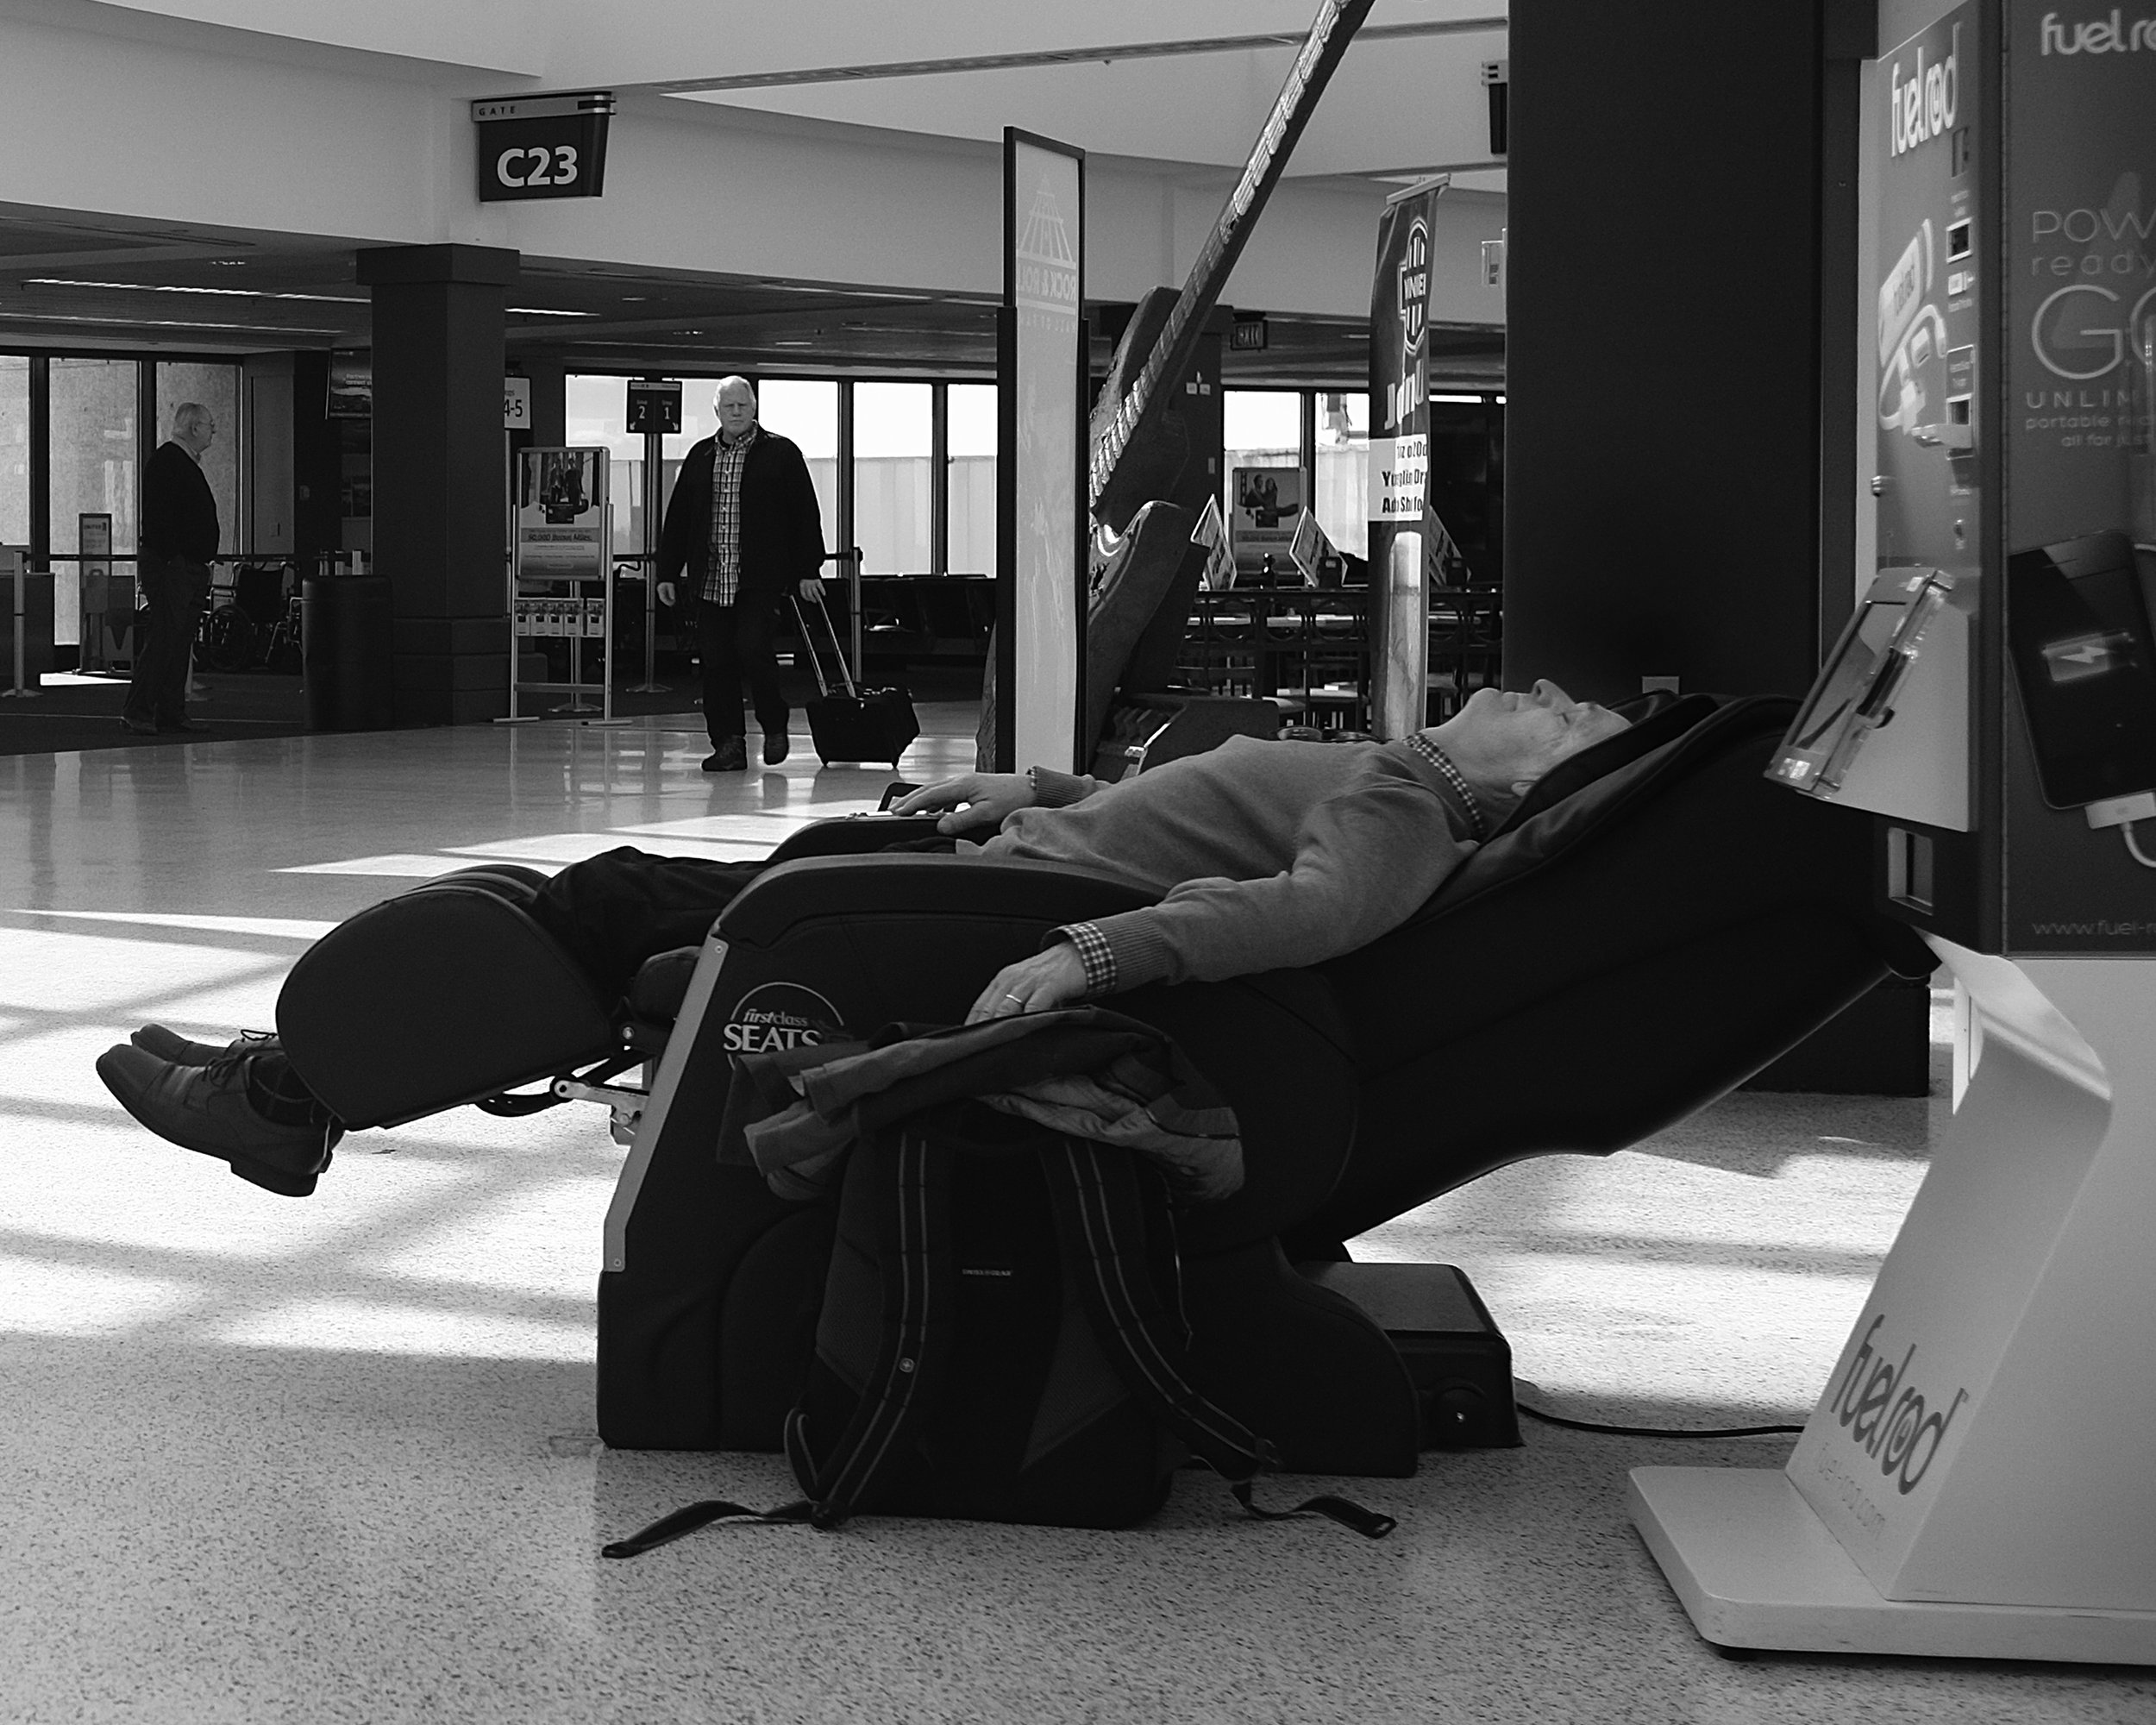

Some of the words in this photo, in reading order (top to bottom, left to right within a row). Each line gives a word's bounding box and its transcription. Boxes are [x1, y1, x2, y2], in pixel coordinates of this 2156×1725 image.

[1891, 22, 1961, 158] fuelrod
[478, 105, 516, 116] GATE
[497, 145, 578, 188] C23
[1236, 323, 1259, 346] EXIT
[2031, 284, 2156, 381] G
[505, 398, 523, 417] 4-5
[638, 405, 646, 419] 2
[664, 406, 670, 420] 1
[2025, 415, 2112, 430] portable
[2085, 434, 2112, 446] for
[723, 1023, 823, 1053] SEATS
[1829, 1314, 1966, 1496] fuelrod
